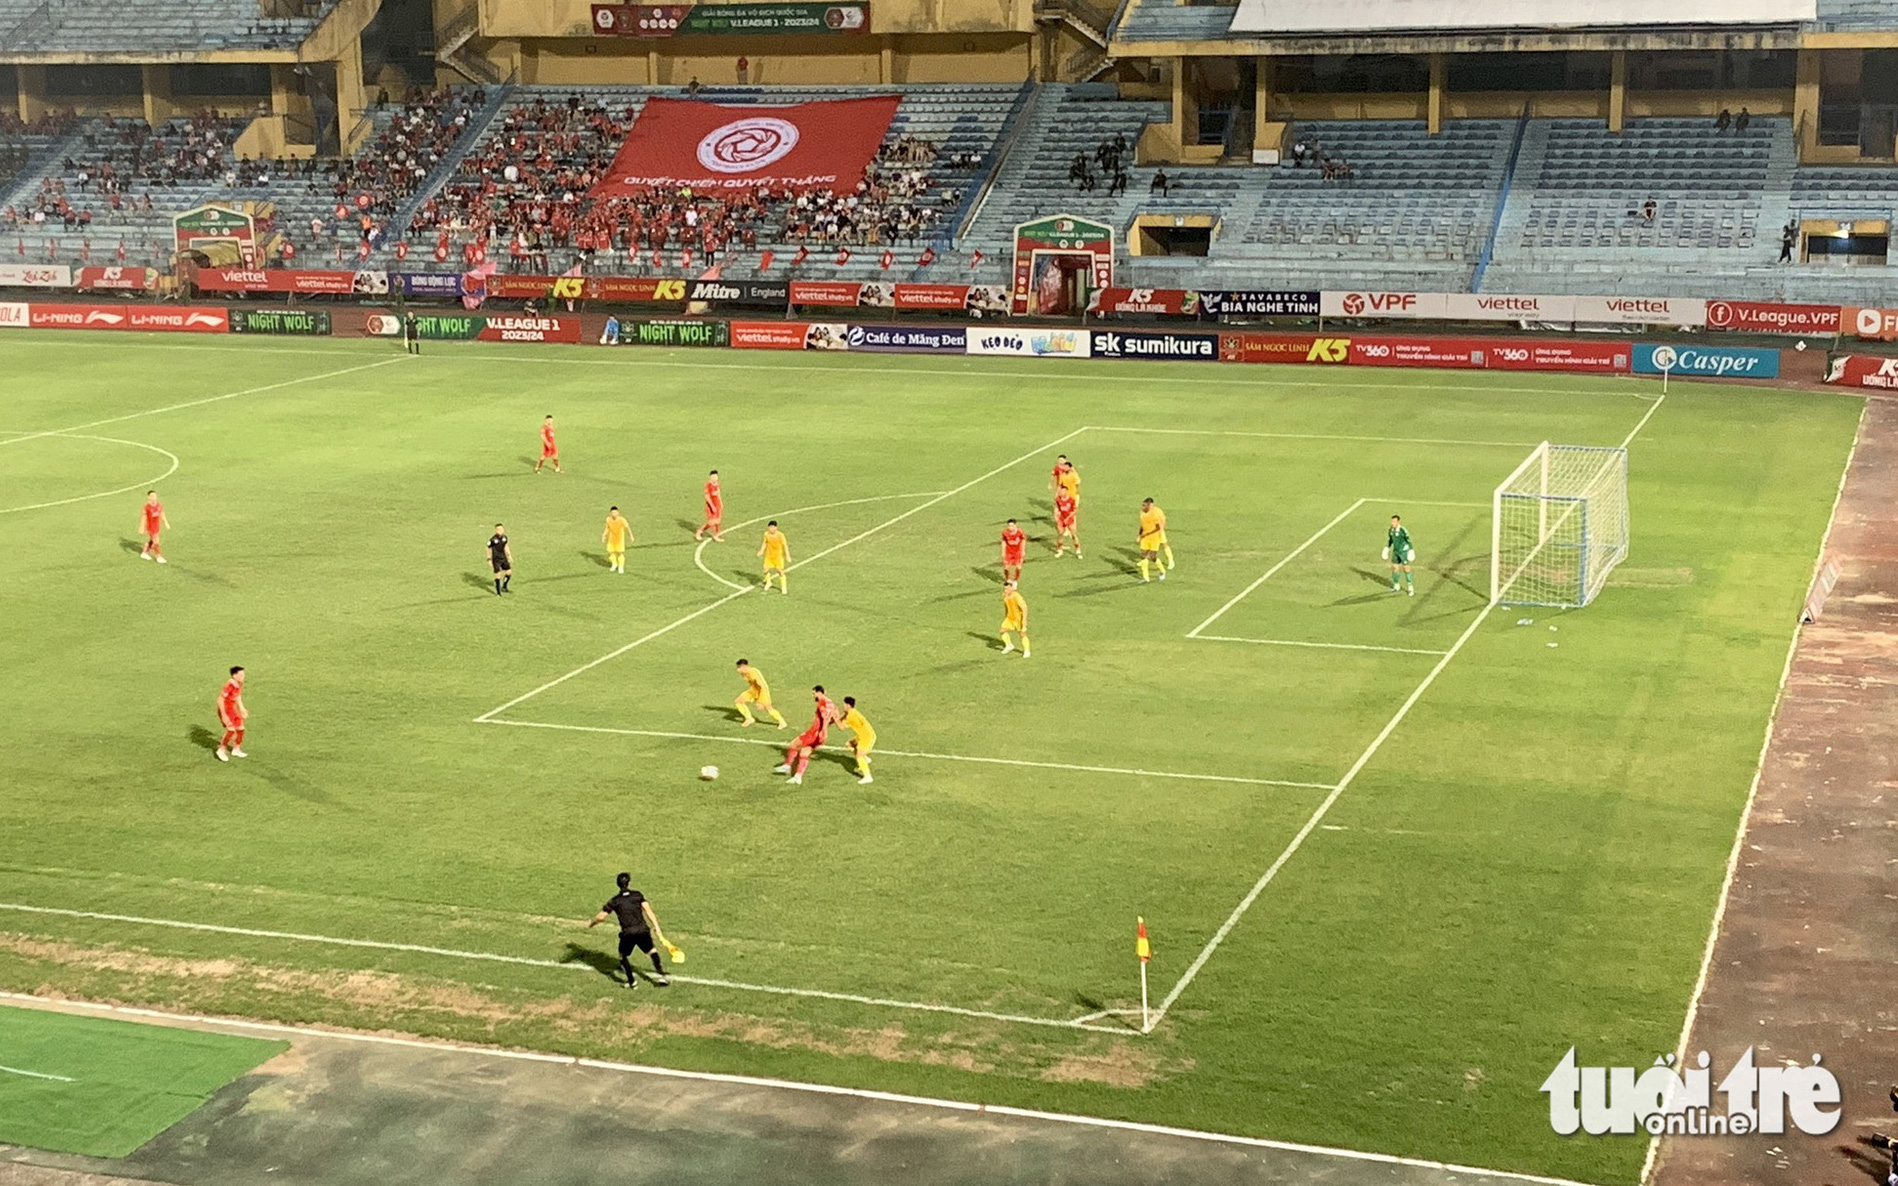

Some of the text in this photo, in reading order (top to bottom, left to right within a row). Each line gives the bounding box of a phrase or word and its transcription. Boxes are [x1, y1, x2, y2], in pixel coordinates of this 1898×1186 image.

[222, 271, 268, 283] viettel
[553, 278, 585, 298] K5
[652, 280, 686, 300] K5
[691, 283, 786, 299] Mitre England
[1127, 289, 1155, 303] K5
[1242, 293, 1307, 301] SAVABECO
[1368, 294, 1416, 310] VPF
[1221, 302, 1243, 313] BIA
[1286, 302, 1319, 313] TINH
[1477, 297, 1540, 310] viettel
[1606, 299, 1670, 313] viettel
[33, 313, 83, 324] LI-NING
[131, 315, 183, 326] LI-NING
[247, 314, 315, 331] NIGHT WOLF
[486, 318, 560, 330] V.LEAGUE 1
[1738, 308, 1838, 326] V.League.VPF
[440, 318, 471, 334] WOLF
[502, 331, 544, 340] 2023/24
[640, 325, 712, 342] NIGHT WOLF
[866, 333, 965, 347] Café de Măng Đen
[1095, 333, 1120, 352] sk
[1125, 336, 1212, 355] sumikura
[1306, 339, 1351, 362] K5
[1356, 345, 1390, 356] TV360
[1493, 348, 1528, 361] TV360
[1679, 351, 1758, 375] Casper
